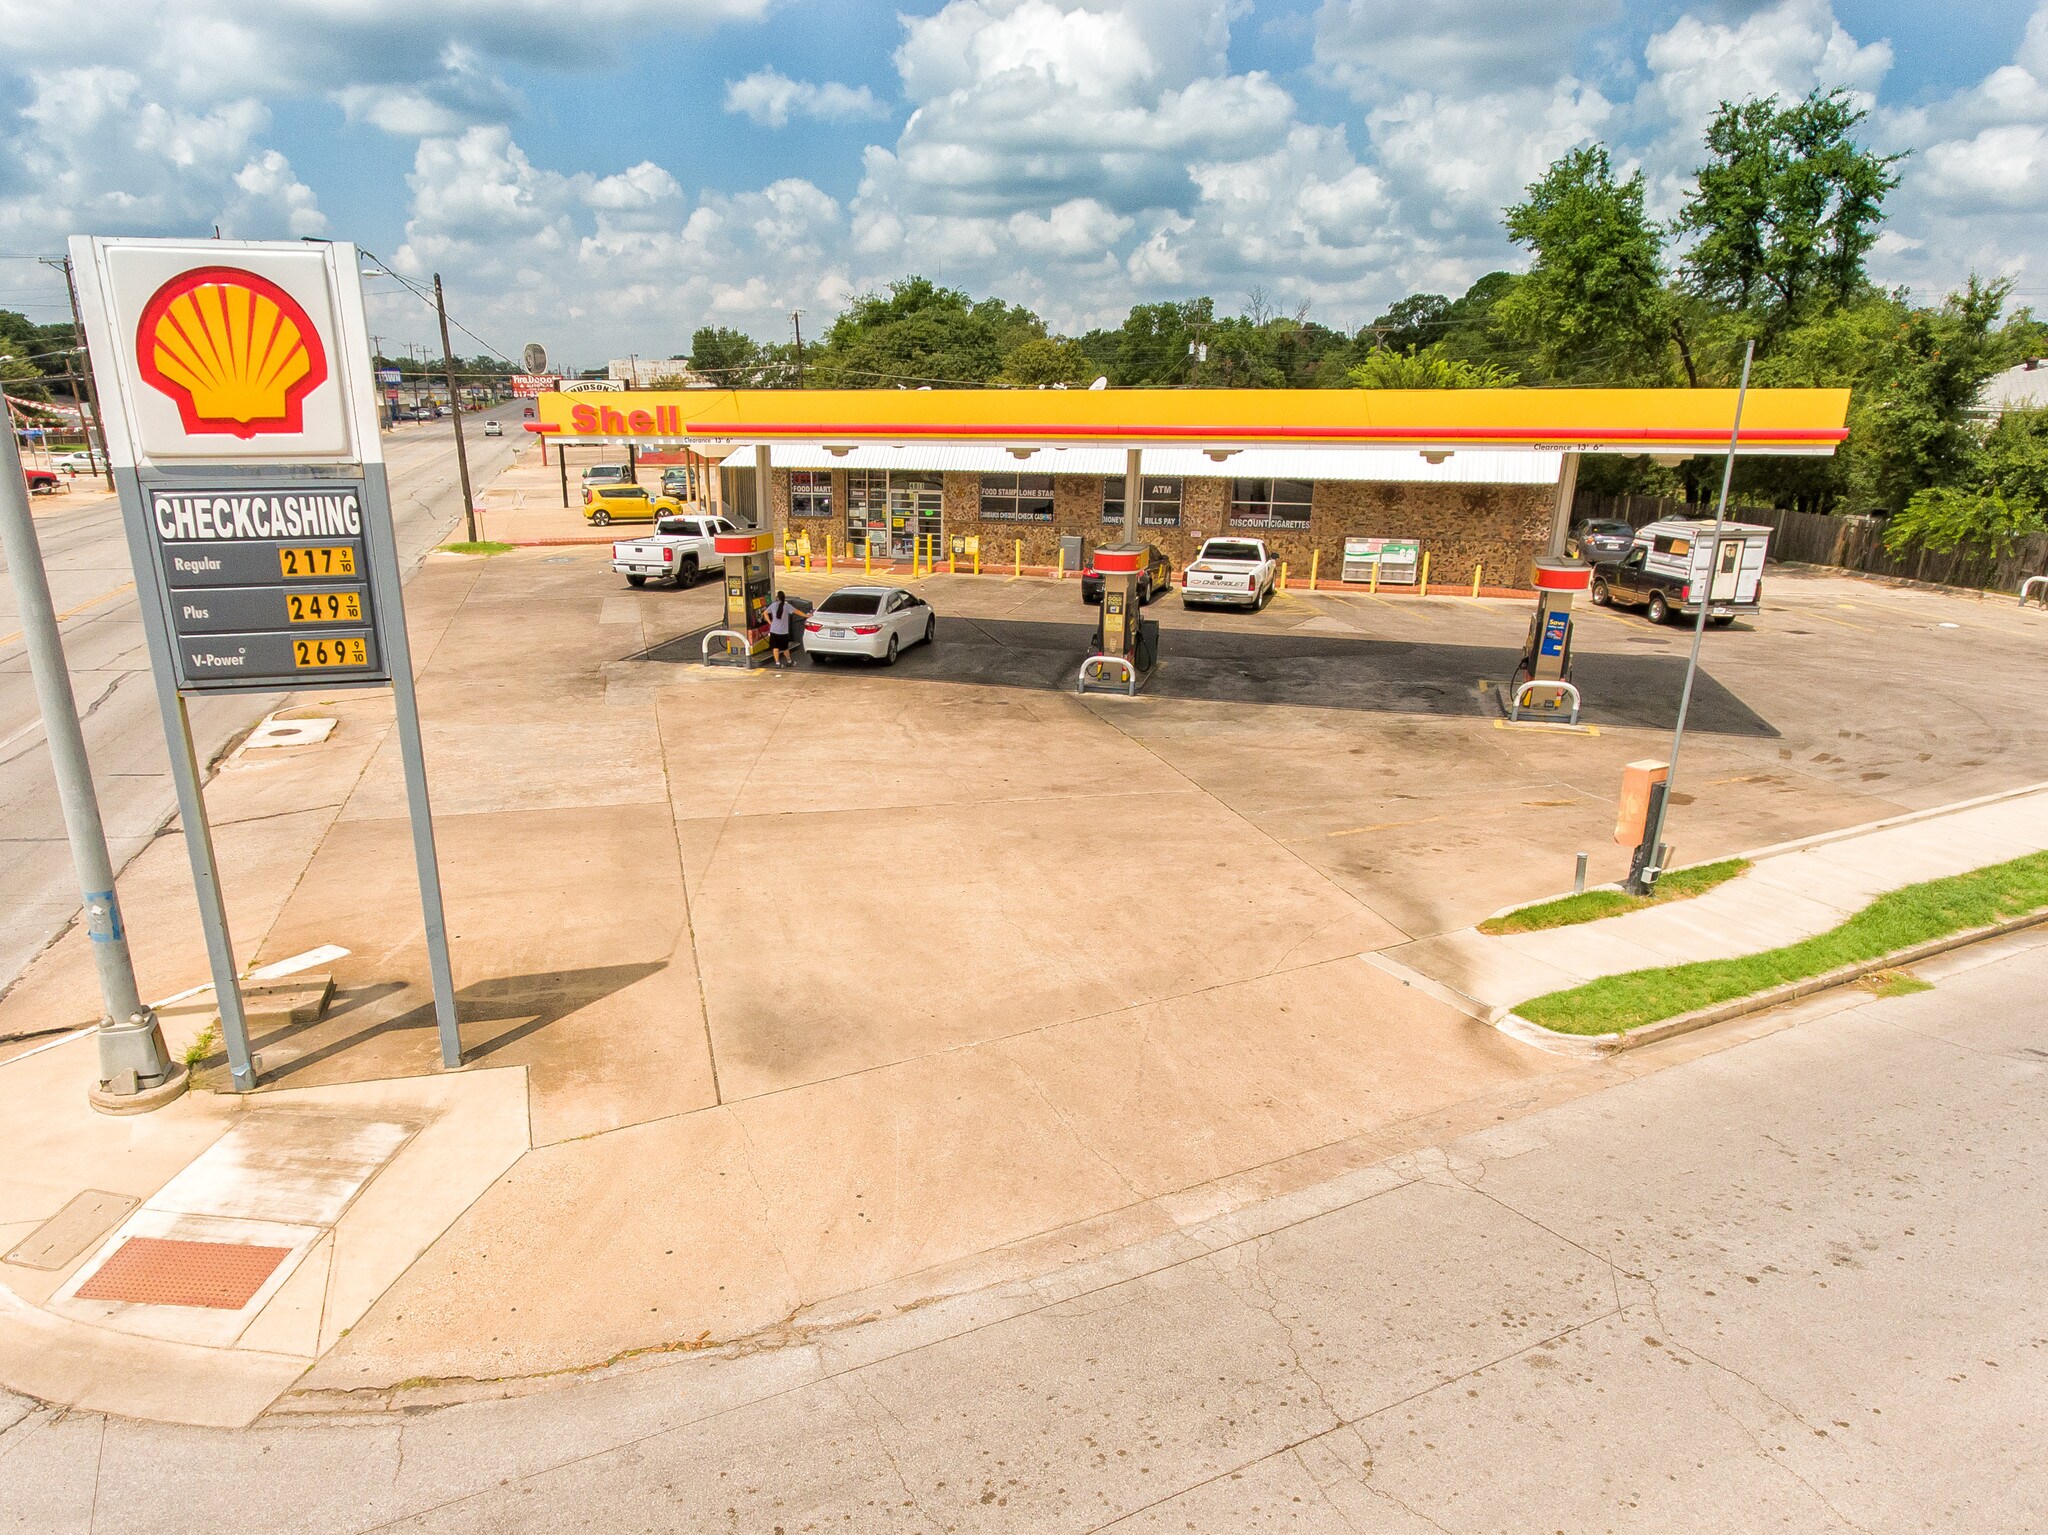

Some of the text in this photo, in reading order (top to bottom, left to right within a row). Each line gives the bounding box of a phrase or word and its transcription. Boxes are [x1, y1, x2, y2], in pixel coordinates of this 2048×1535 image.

[572, 404, 680, 433] Shell
[1533, 443, 1572, 451] Clearance
[813, 485, 832, 493] MART
[1019, 489, 1036, 497] LONE
[1152, 485, 1172, 494] ATM
[155, 495, 360, 539] CHECKCASHING
[1144, 517, 1162, 525] BILLS
[1229, 519, 1310, 529] DISCOUNT CIGARETTES
[751, 538, 757, 551] 5
[174, 556, 222, 574] Regular
[284, 549, 332, 574] 217
[183, 605, 209, 620] Plus
[291, 595, 339, 620] 249
[1549, 618, 1566, 626] Save
[192, 652, 244, 667] V-Power
[297, 641, 347, 665] 269
